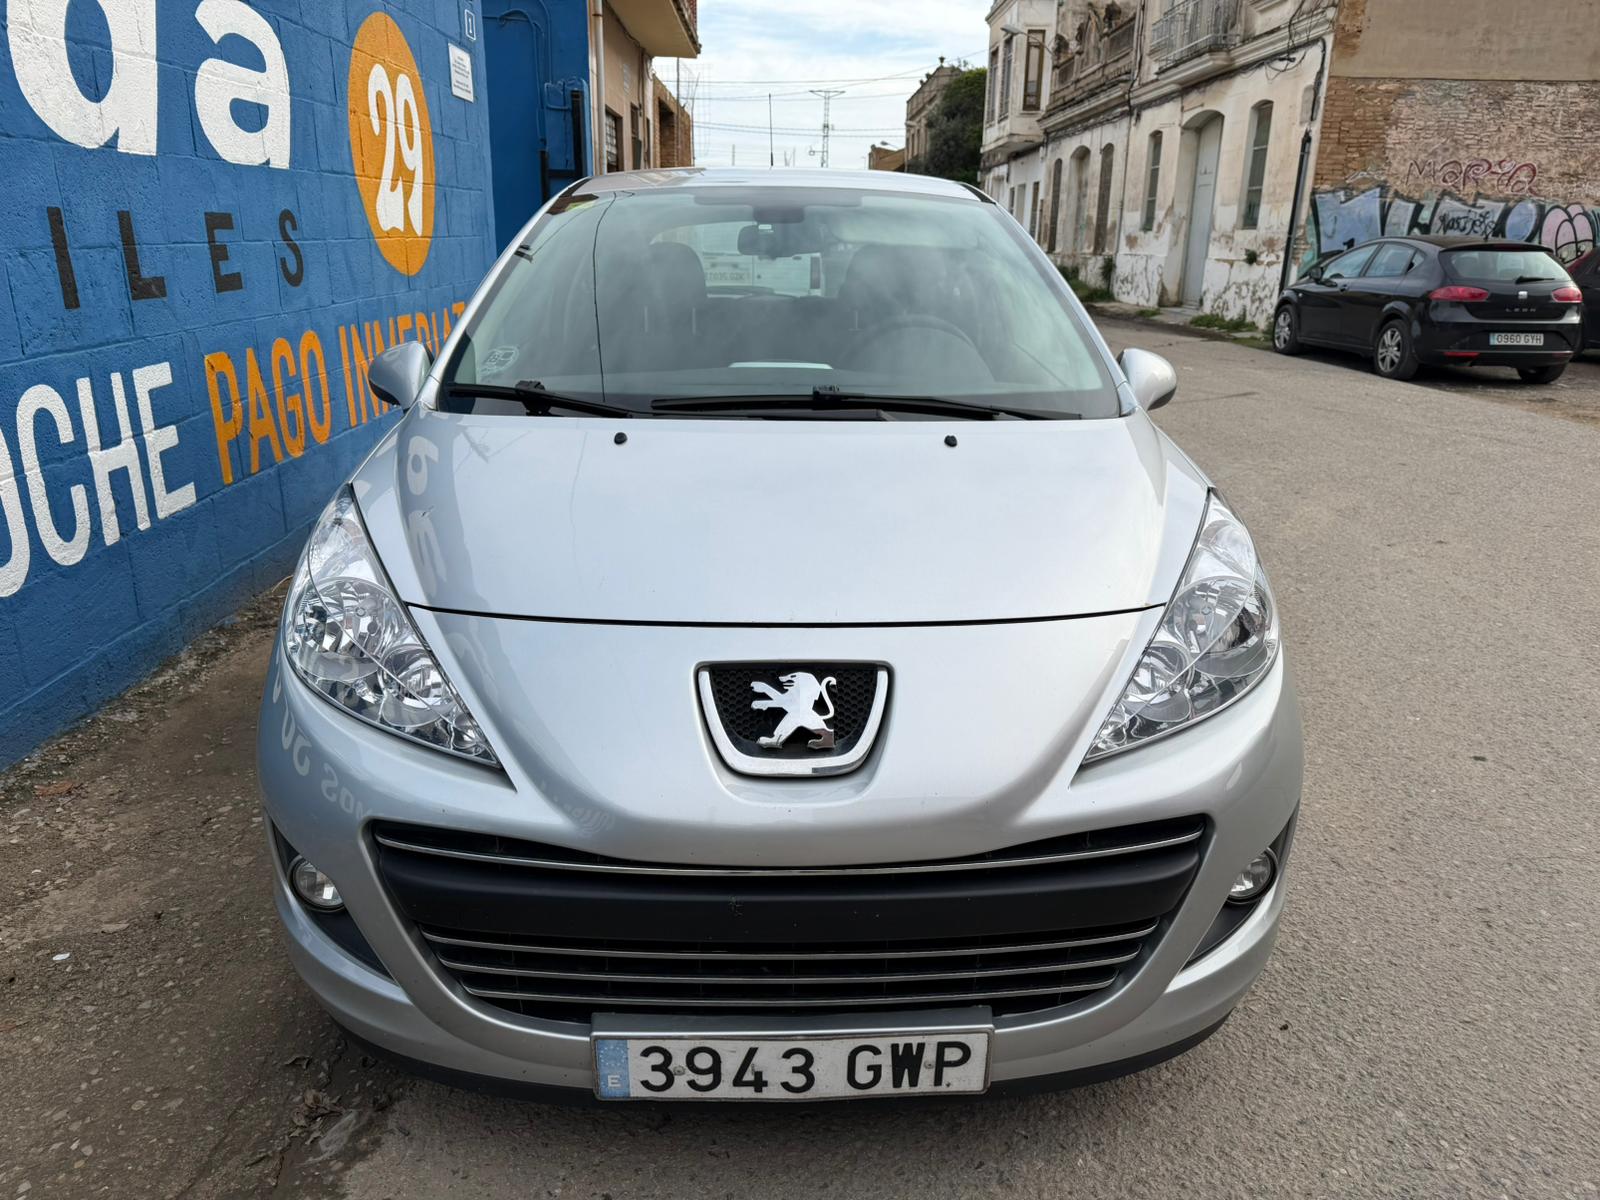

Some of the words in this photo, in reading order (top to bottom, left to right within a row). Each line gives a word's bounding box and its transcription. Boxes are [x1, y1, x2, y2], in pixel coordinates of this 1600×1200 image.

[368, 64, 423, 236] 29
[1497, 334, 1521, 344] 0960
[204, 329, 332, 484] PAGO
[607, 1074, 622, 1088] E
[639, 1046, 815, 1094] 3943
[846, 1041, 972, 1090] GWP
